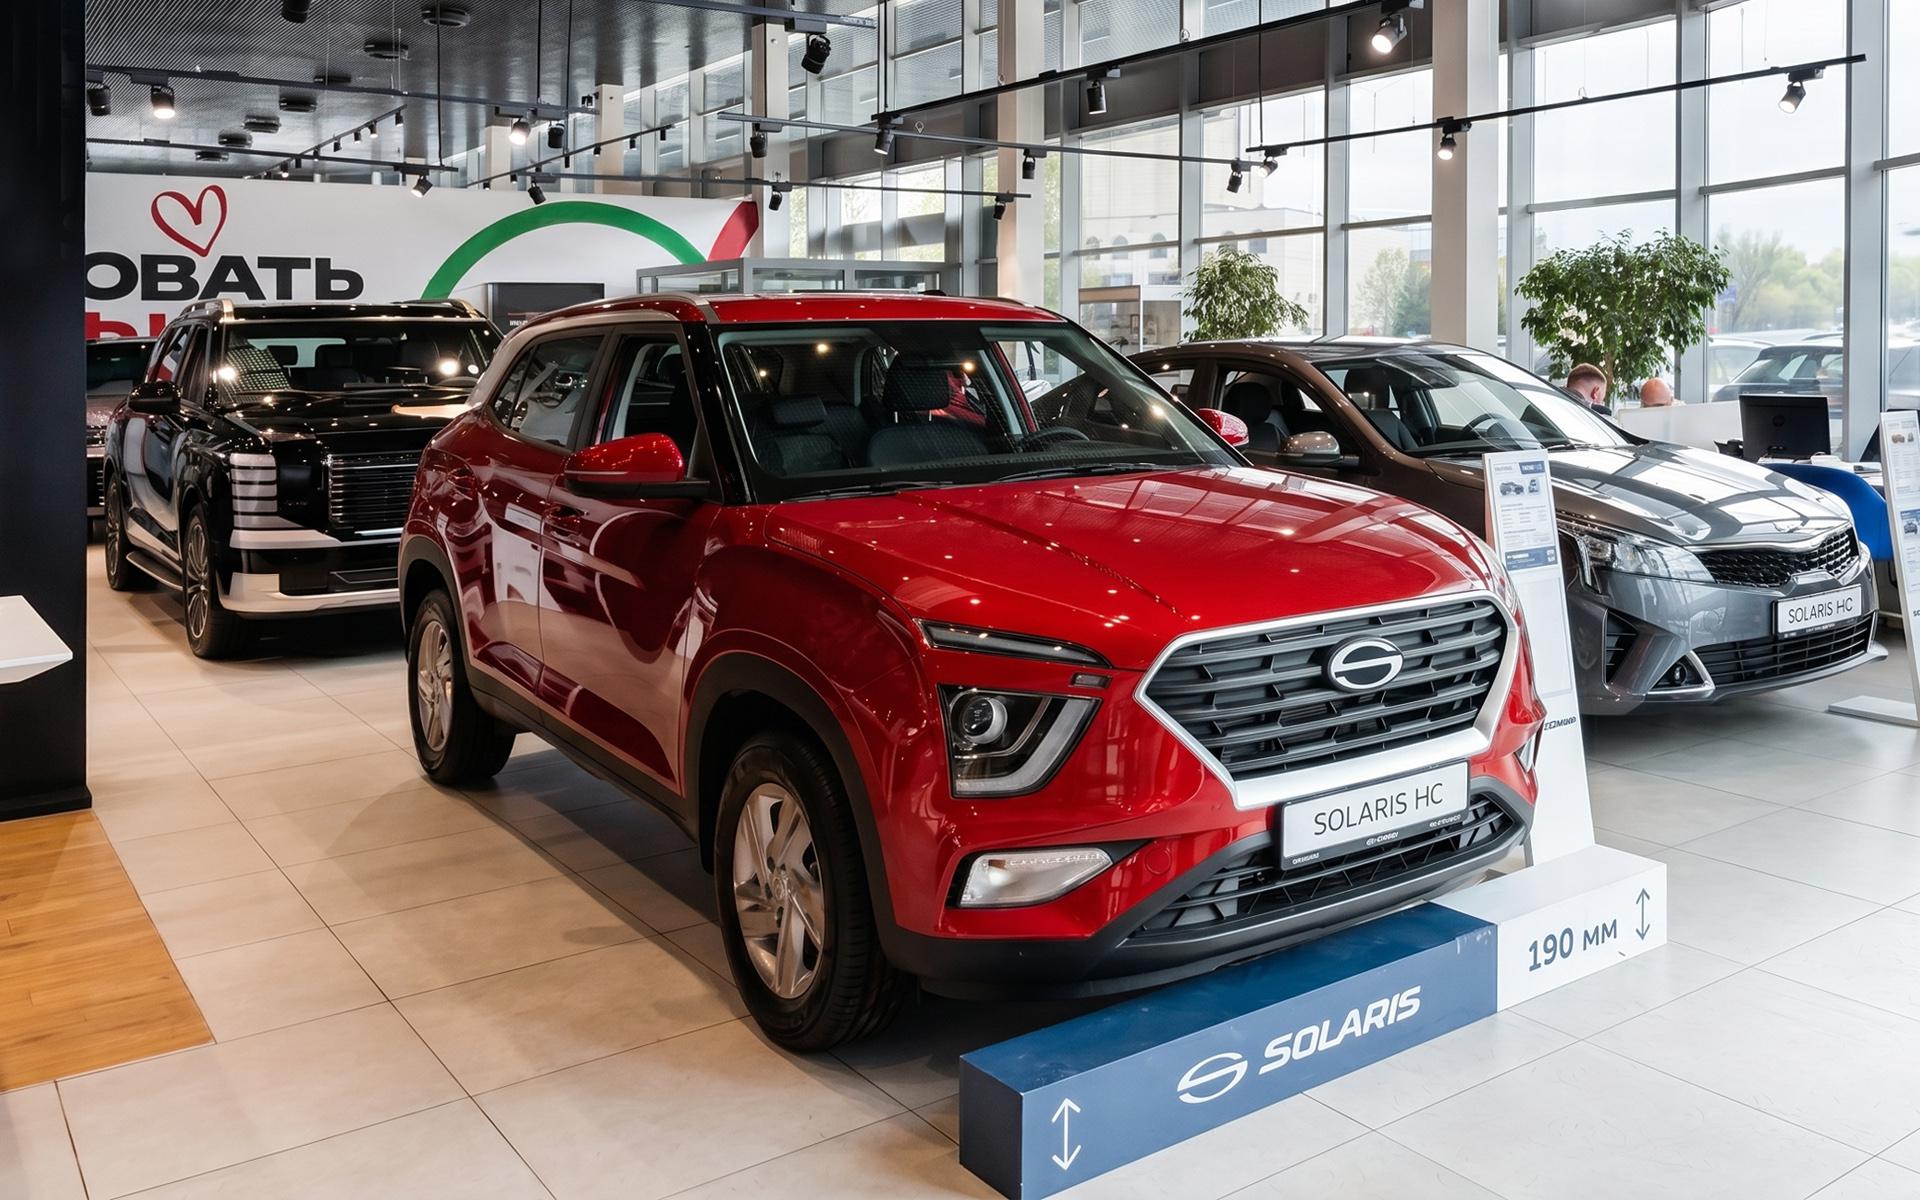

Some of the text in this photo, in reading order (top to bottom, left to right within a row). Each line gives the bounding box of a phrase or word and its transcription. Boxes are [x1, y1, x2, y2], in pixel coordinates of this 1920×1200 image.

[1788, 597, 1853, 623] SOLARIS HC
[1313, 782, 1444, 836] SOLARIS HC
[1528, 927, 1574, 972] 190
[1258, 985, 1422, 1076] SOLARIS
